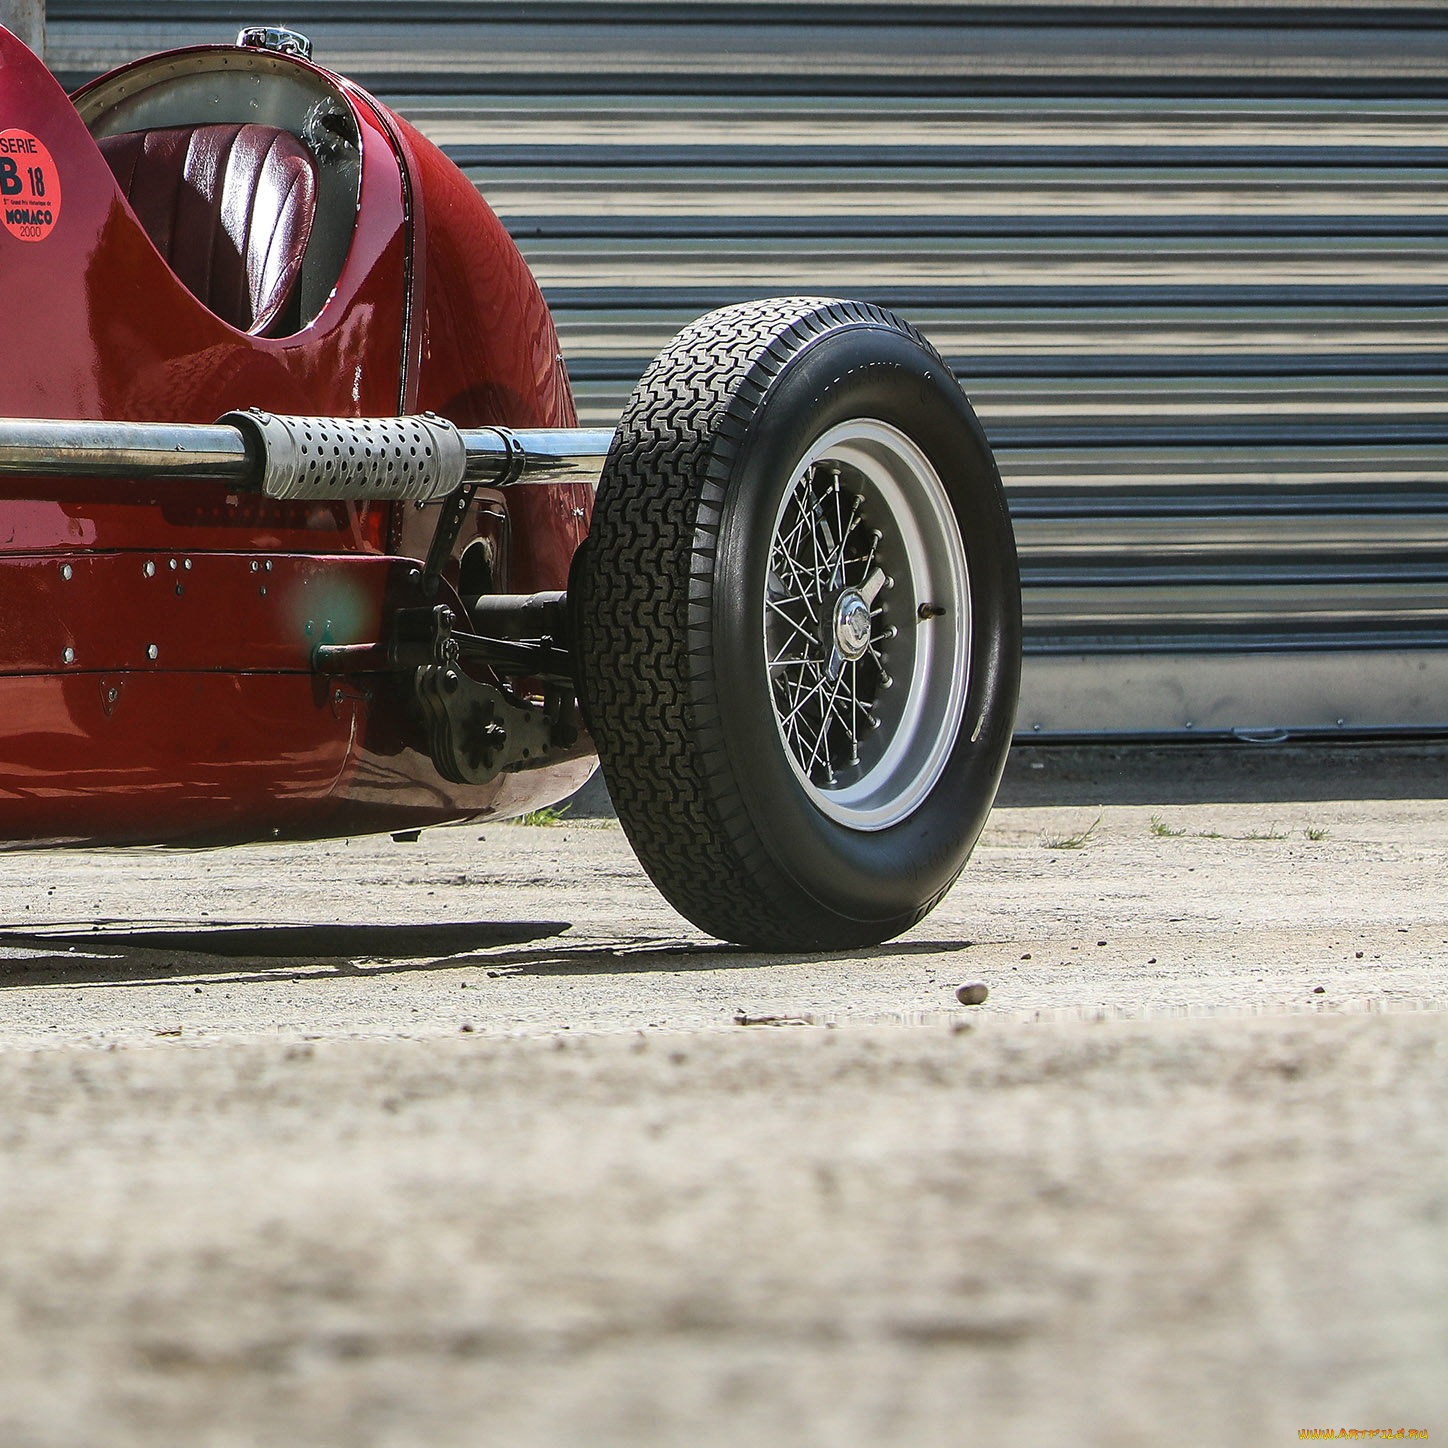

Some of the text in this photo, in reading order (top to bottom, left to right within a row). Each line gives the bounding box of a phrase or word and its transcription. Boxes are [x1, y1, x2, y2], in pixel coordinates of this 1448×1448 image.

[0, 138, 38, 153] SERIE
[27, 167, 45, 197] 18
[5, 208, 53, 225] MONACO
[20, 226, 41, 237] 2000
